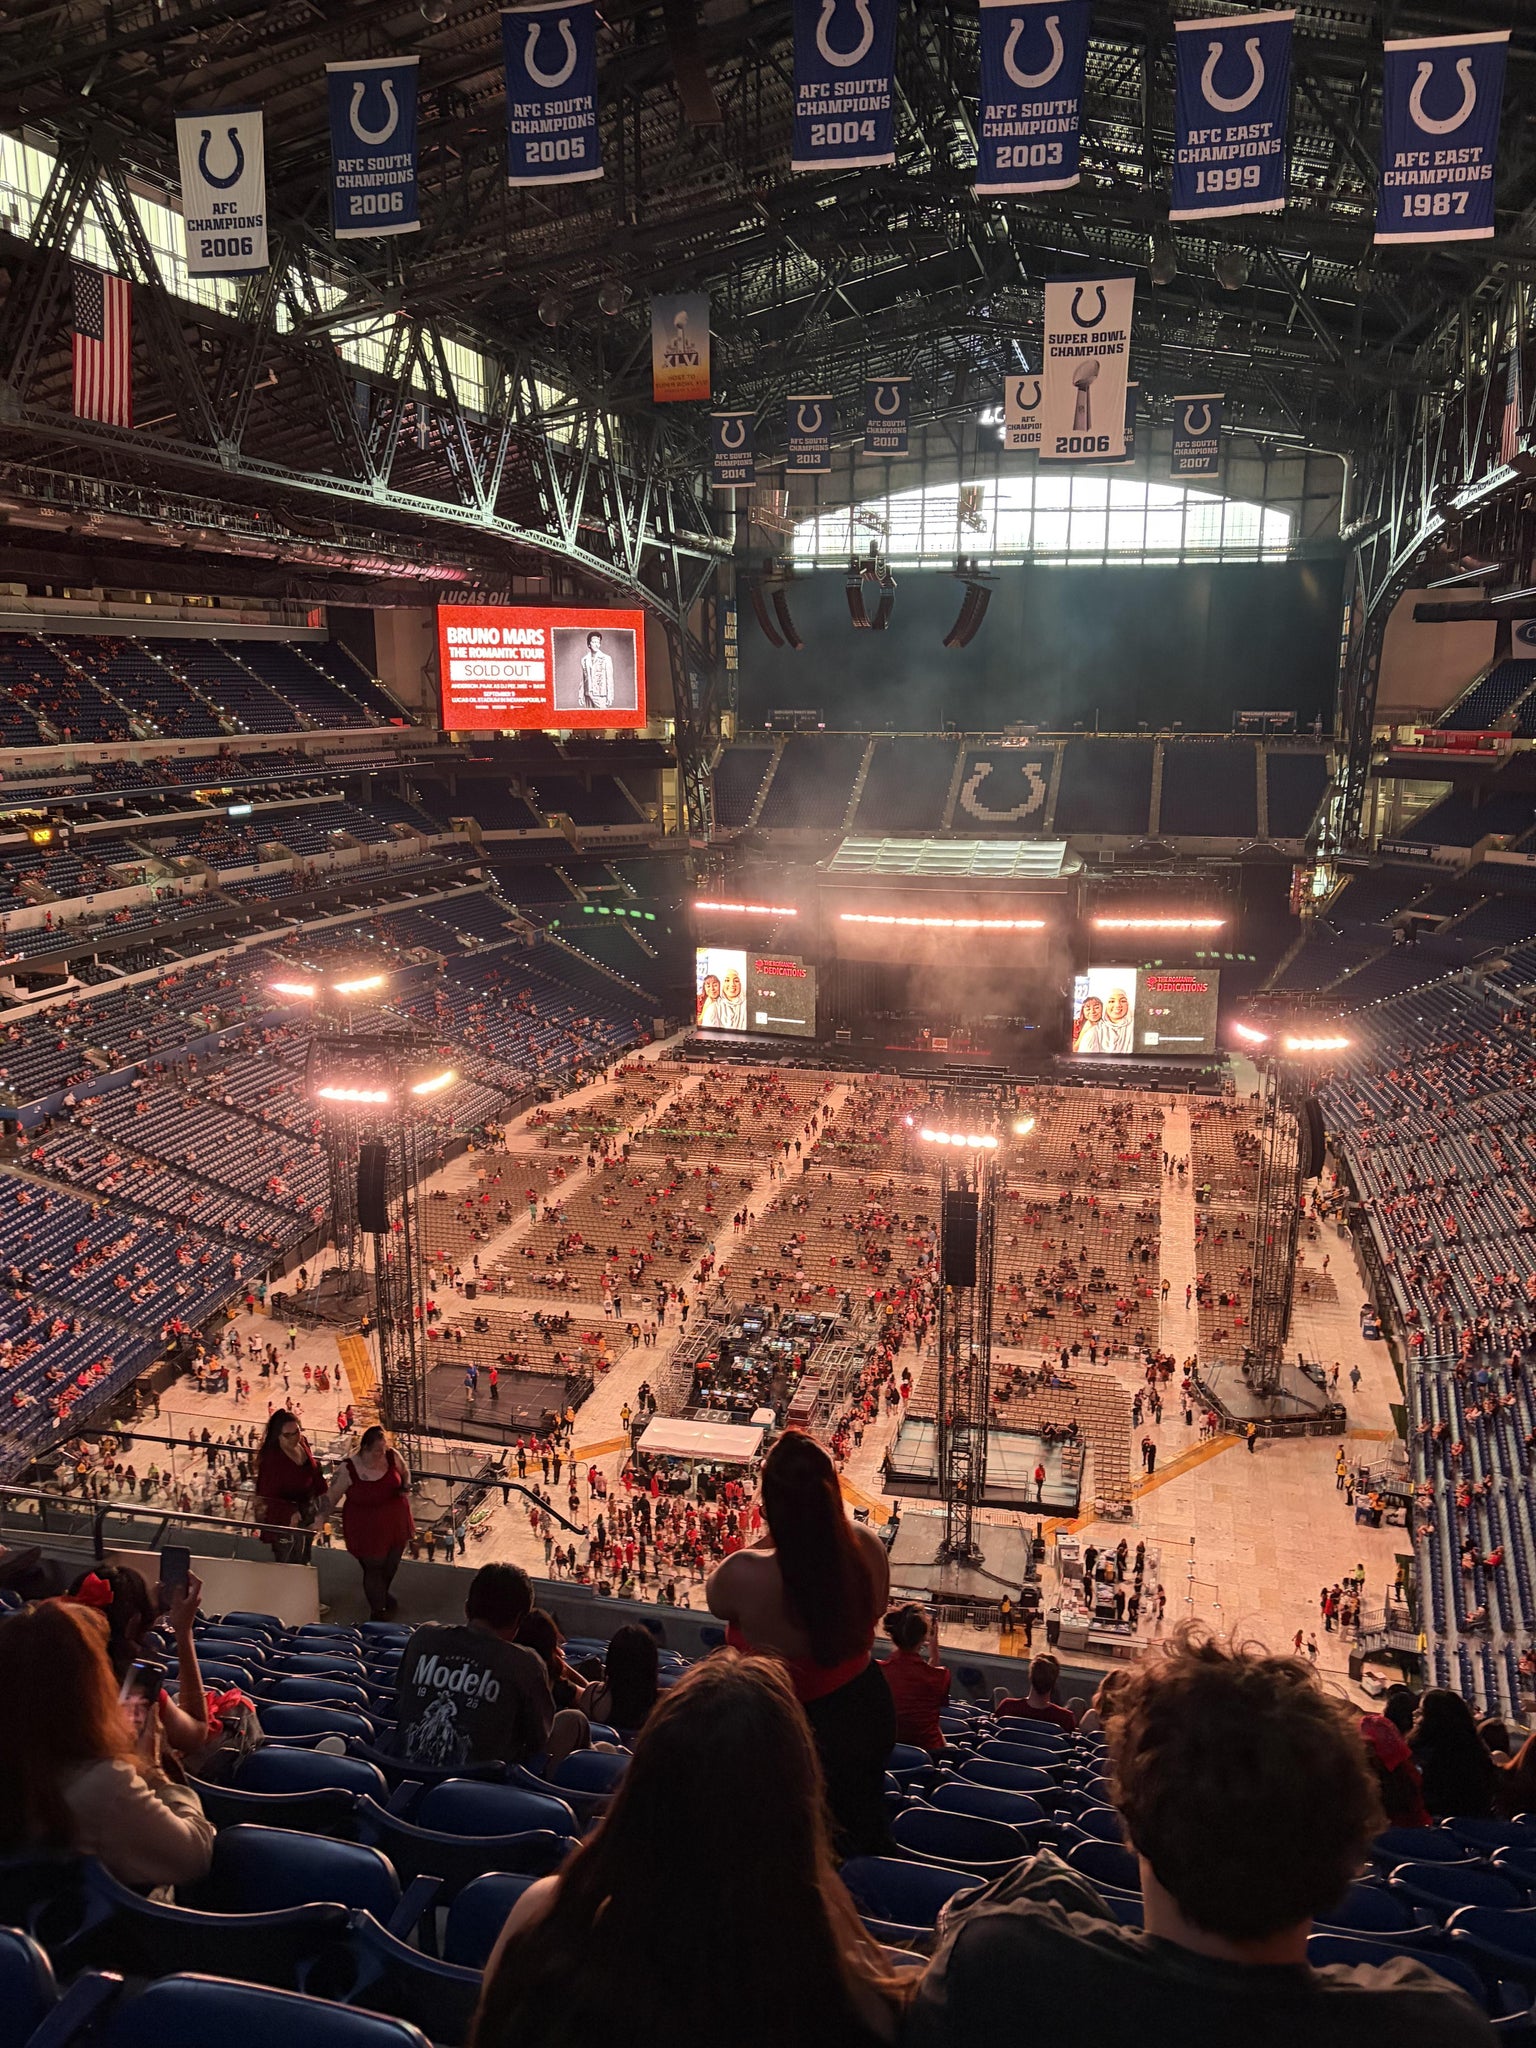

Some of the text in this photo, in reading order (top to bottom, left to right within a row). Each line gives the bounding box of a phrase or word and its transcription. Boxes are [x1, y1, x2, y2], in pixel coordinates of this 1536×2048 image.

[799, 78, 888, 98] AFC SOUTH
[514, 96, 592, 117] AFC SOUTH
[796, 94, 890, 116] CHAMPIONS
[985, 99, 1077, 119] AFC SOUTH
[512, 113, 595, 134] CHAMPIONS
[983, 116, 1079, 137] CHAMPIONS
[811, 120, 876, 146] 2004
[1187, 122, 1273, 145] AFC EAST
[526, 137, 585, 162] 2005
[996, 143, 1063, 168] 2003
[1178, 138, 1281, 163] CHAMPIONS
[1394, 147, 1483, 168] AFC EAST
[338, 154, 412, 172] AFC SOUTH
[336, 169, 414, 188] CHAMPIONS
[1196, 165, 1260, 194] 1999
[1384, 164, 1493, 186] CHAMPIONS
[212, 202, 237, 215] AFC
[350, 192, 403, 215] 2006
[1402, 192, 1469, 217] 1987
[187, 215, 263, 231] CHAMPIONS
[201, 237, 253, 258] 2006
[1049, 330, 1126, 344] SUPER BOWL
[1050, 343, 1124, 357] CHAMPIONS
[873, 437, 899, 447] 2010
[1013, 433, 1041, 443] 2009
[1056, 436, 1110, 454] 2006
[797, 455, 821, 464] 2013
[1174, 447, 1218, 455] CHAMPIONS
[1180, 458, 1210, 469] 2007
[722, 469, 746, 479] 2014
[439, 591, 511, 605] LUCAS OIL
[447, 627, 544, 645] BRUNO MARS
[449, 647, 544, 659] THE ROMANTIC TOUR
[465, 665, 531, 676] SOLD OUT
[764, 967, 807, 978] DEDICATIONS
[1156, 983, 1208, 992] DEDICATIONS
[412, 1654, 500, 1702] Modelo
[417, 1687, 427, 1697] 19
